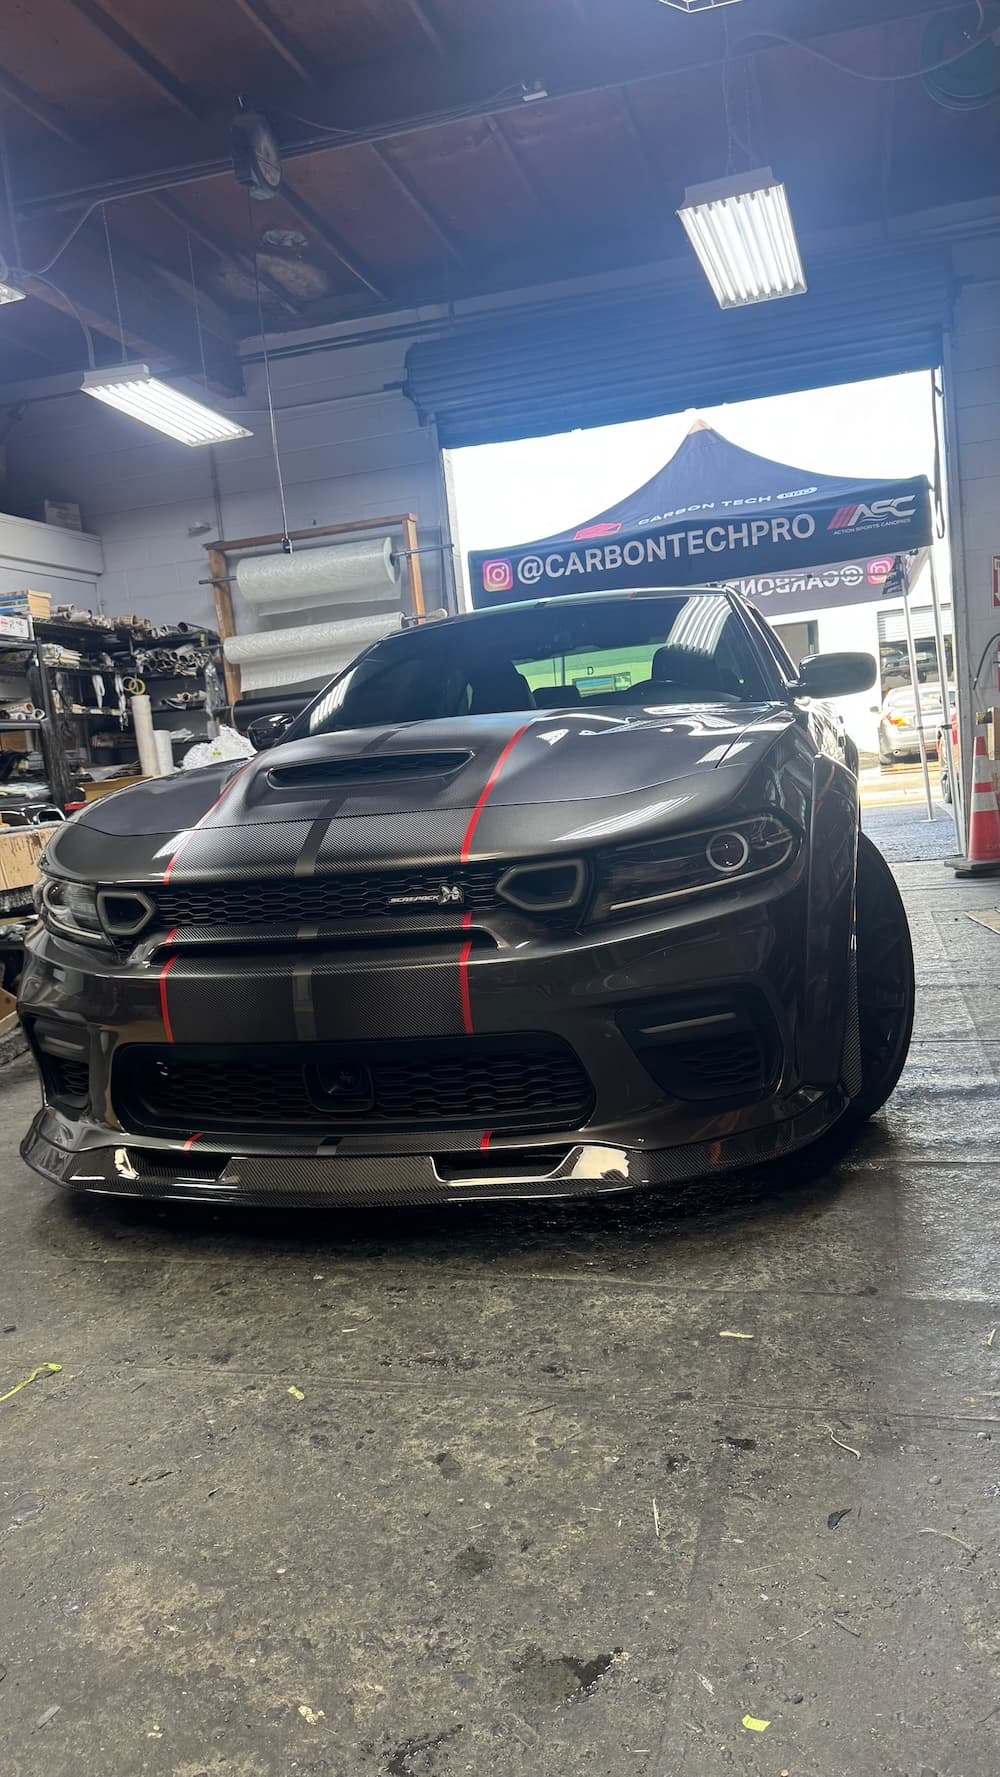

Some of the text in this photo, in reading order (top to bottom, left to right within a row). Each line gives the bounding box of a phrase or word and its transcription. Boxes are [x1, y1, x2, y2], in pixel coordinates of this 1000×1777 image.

[638, 495, 772, 526] CARBON TECH
[847, 495, 916, 526] ASC
[517, 513, 816, 584] @CARBONTECHPRO
